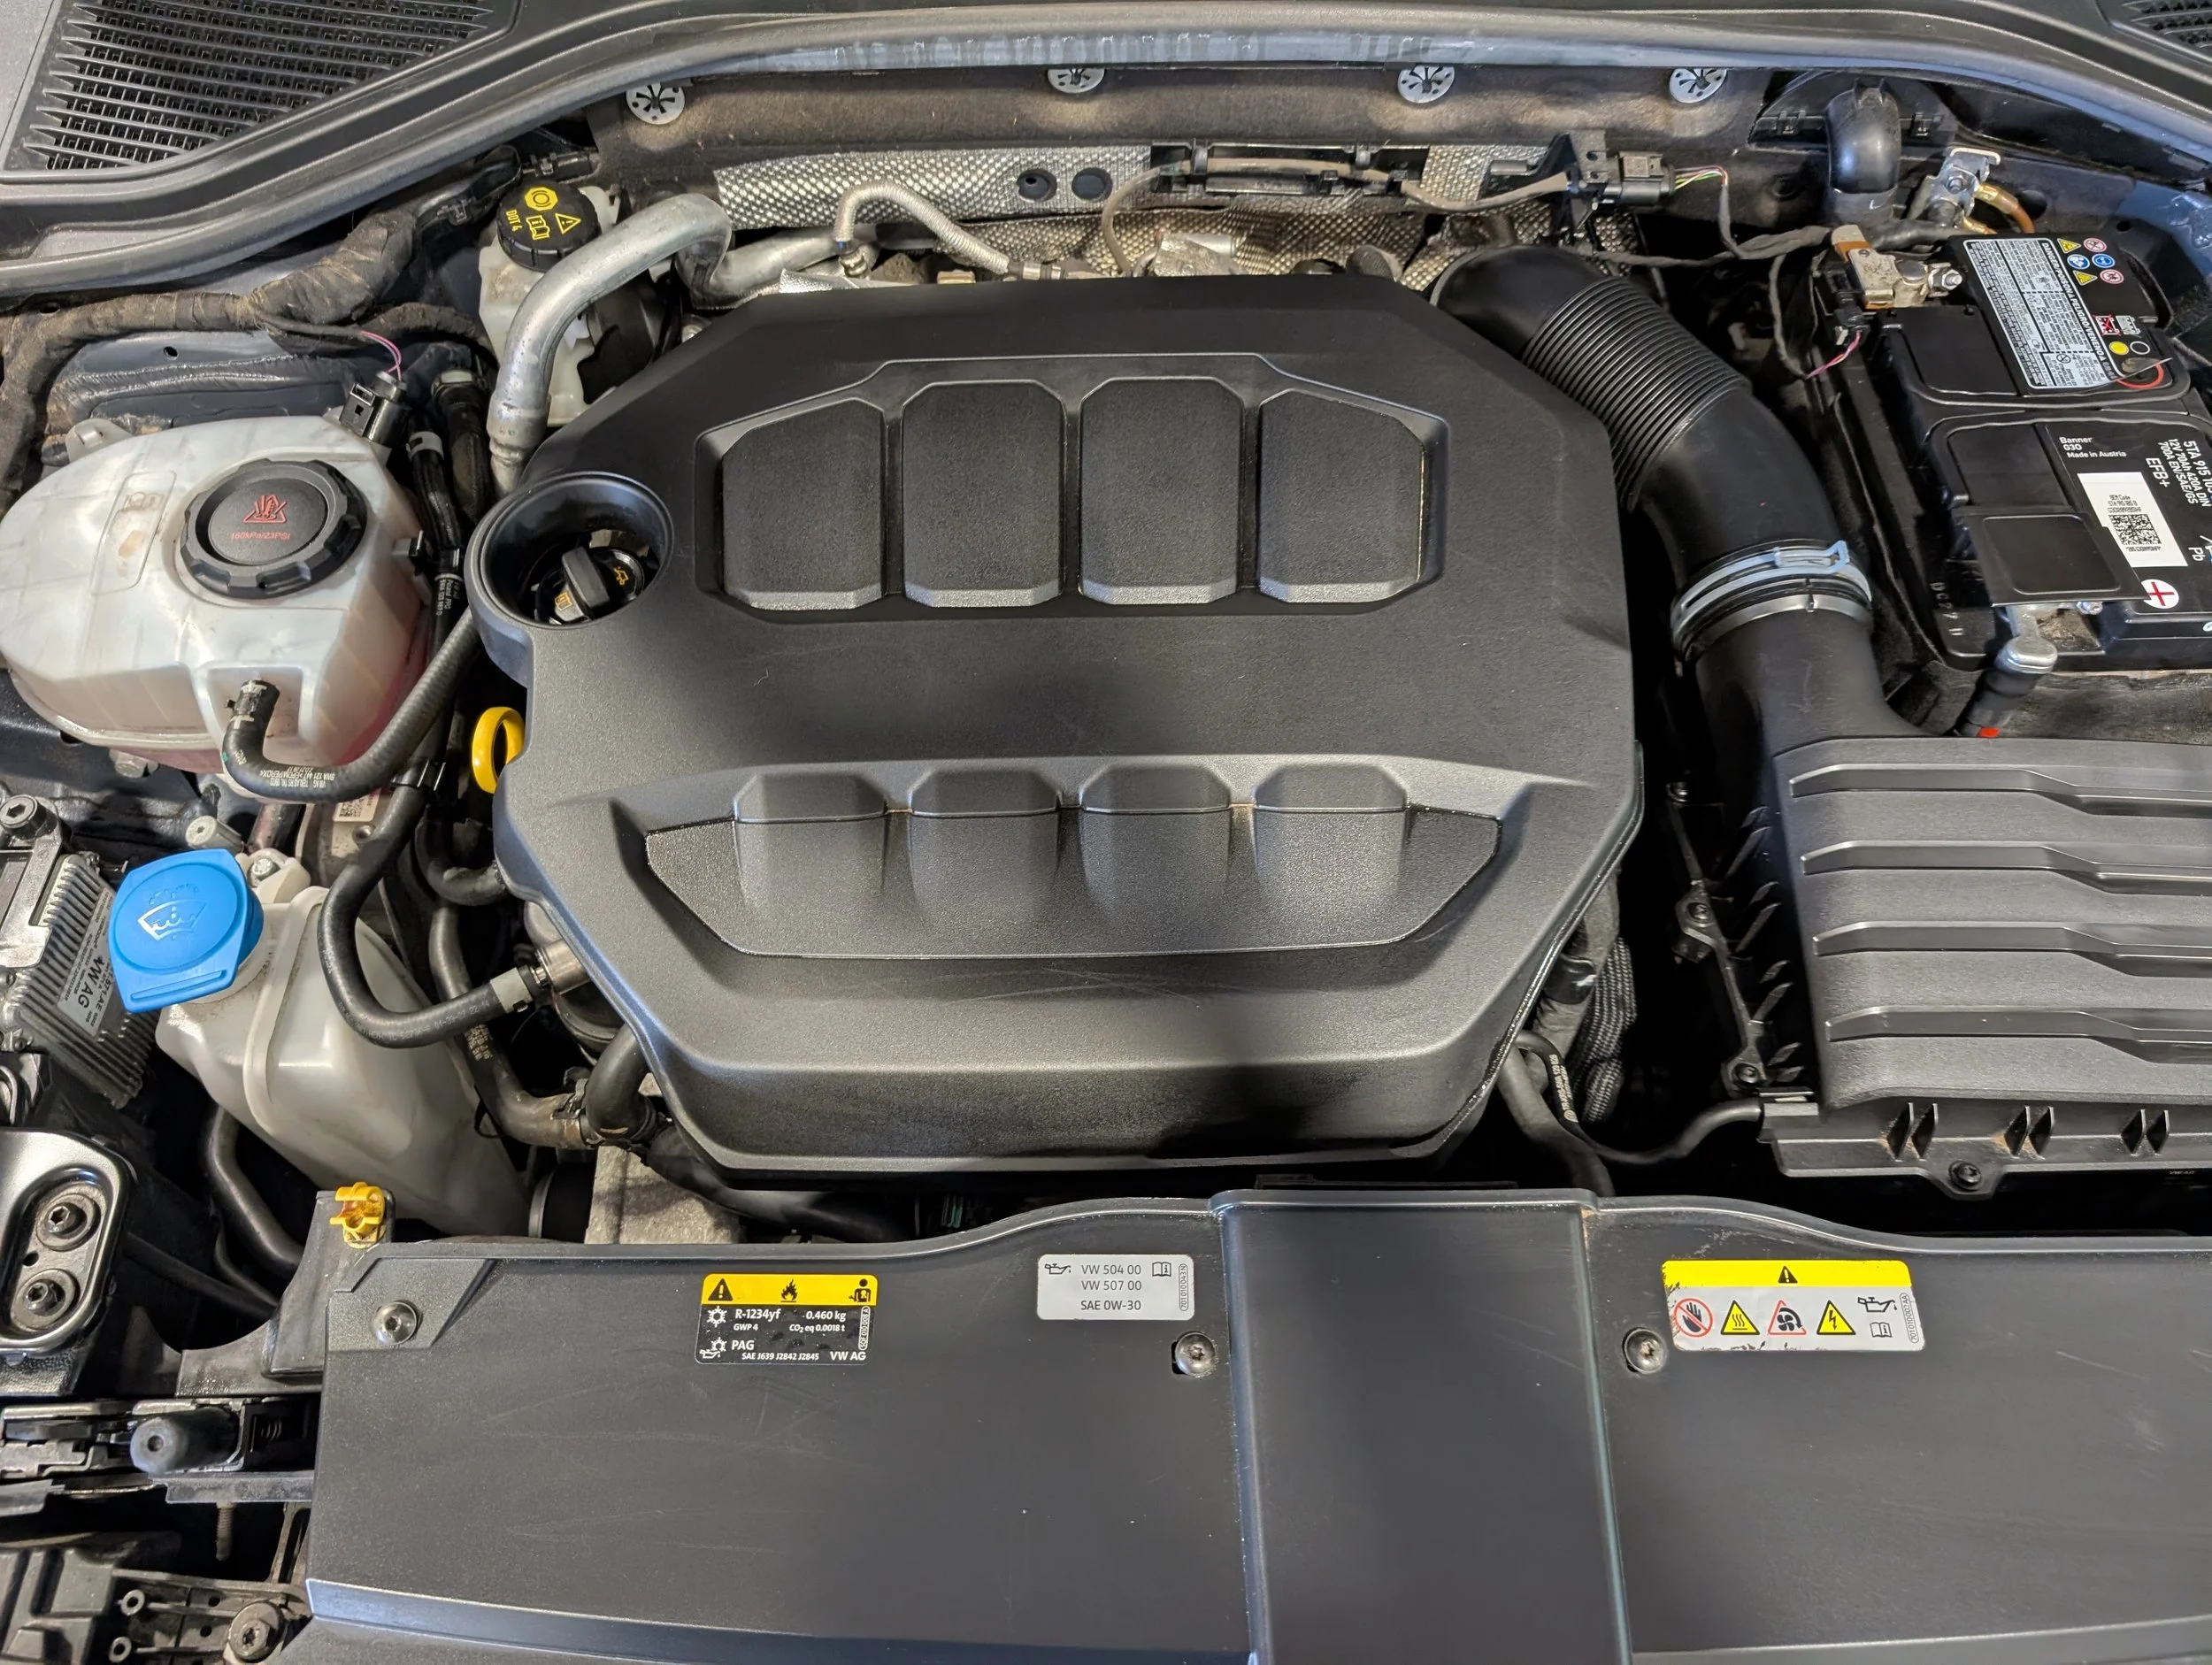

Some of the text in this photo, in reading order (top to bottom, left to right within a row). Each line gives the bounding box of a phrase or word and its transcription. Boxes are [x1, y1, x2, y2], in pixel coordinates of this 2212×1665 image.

[506, 209, 521, 224] DOT
[2183, 441, 2202, 459] 5TA
[2193, 460, 2212, 476] 915
[2146, 457, 2170, 488] EFB+
[2158, 441, 2199, 504] 700A EN/SAE/GS
[2168, 439, 2212, 507] 12V 70Ah 420A DIN
[231, 532, 291, 541] 160kPa/23PSI
[2187, 547, 2206, 562] Pb
[88, 957, 105, 986] VW
[77, 981, 94, 1009] AG
[1081, 1264, 1142, 1275] VW 504 00
[1081, 1280, 1142, 1291] VW 507 00
[1080, 1300, 1141, 1311] SAE 0W-30
[734, 1308, 847, 1324] R-1234yf 0.460 kg
[804, 1325, 815, 1334] eq
[816, 1324, 841, 1332] 0.0018
[731, 1340, 755, 1351] PAG
[830, 1351, 850, 1361] VW
[850, 1351, 867, 1361] AG
